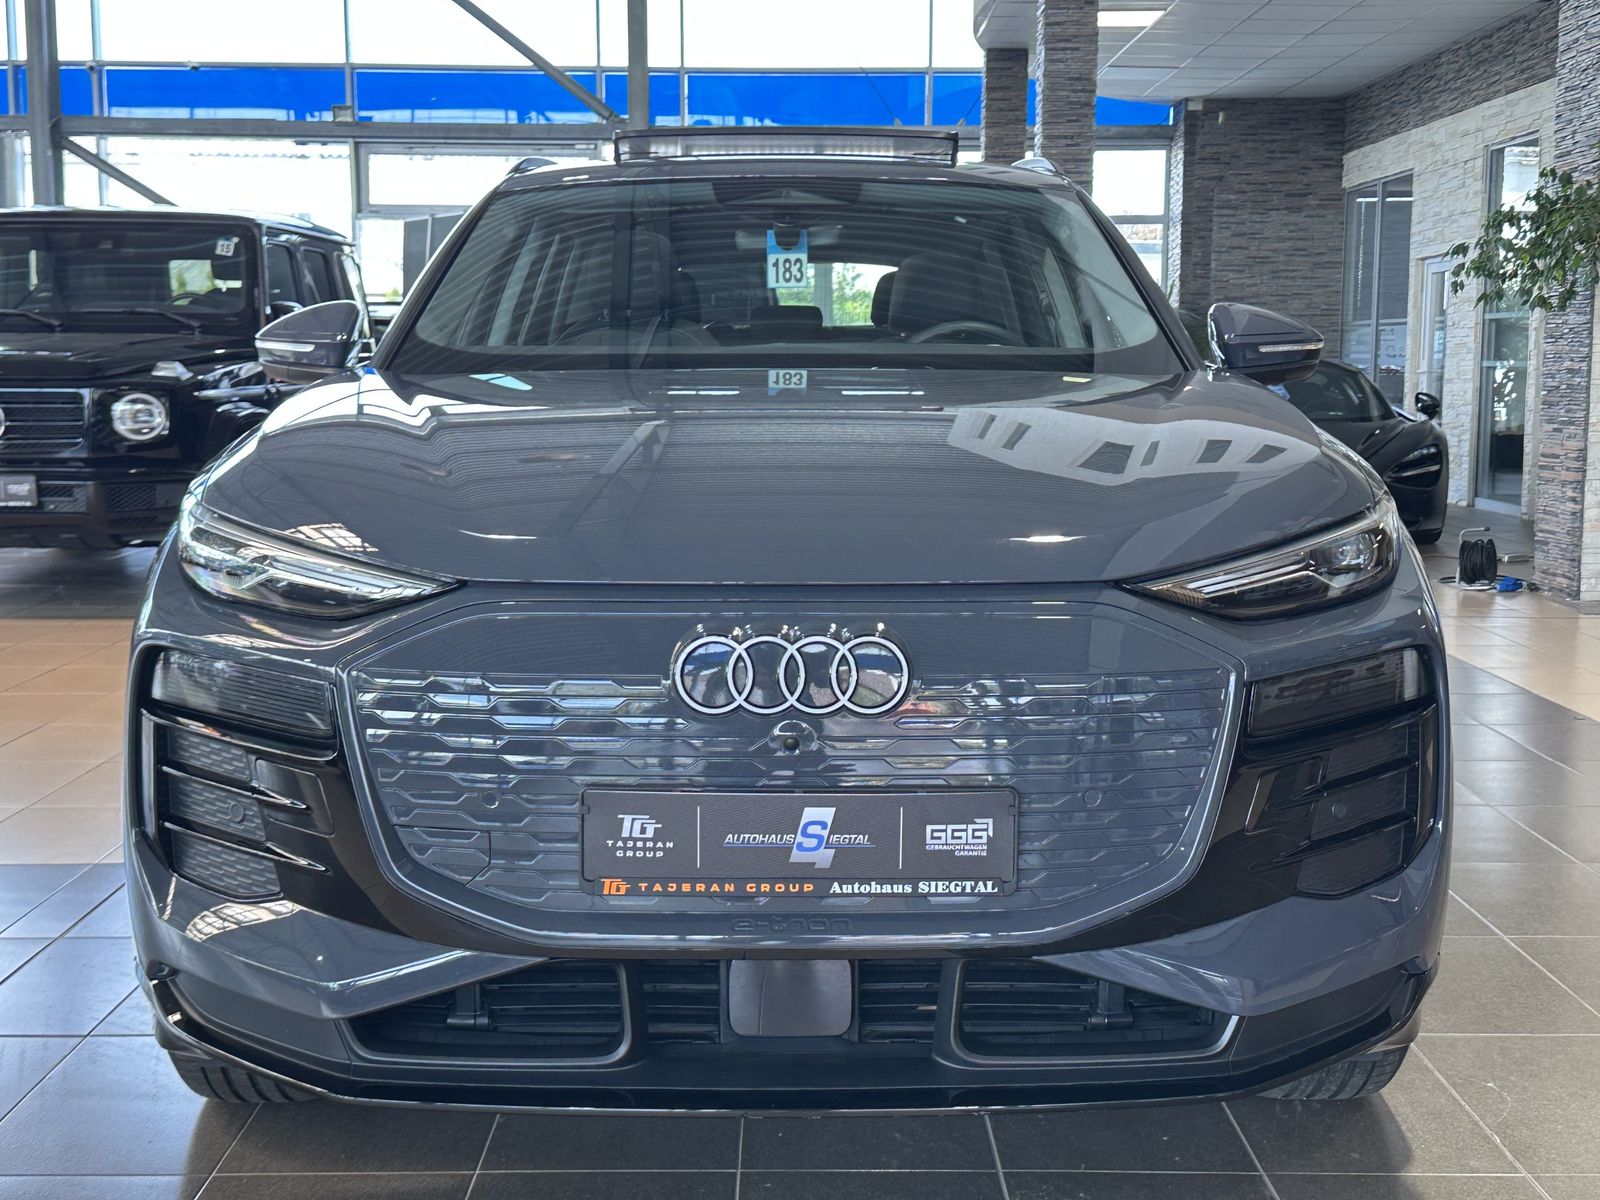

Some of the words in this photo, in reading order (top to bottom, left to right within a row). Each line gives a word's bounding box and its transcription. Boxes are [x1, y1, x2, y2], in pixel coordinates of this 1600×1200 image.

[772, 258, 804, 284] 183
[724, 833, 796, 845] AUTOHAUS
[926, 824, 988, 844] GGG
[606, 840, 674, 849] TAJERAN
[615, 850, 664, 858] GROUP
[638, 882, 735, 893] TAJERAN
[746, 882, 814, 893] GROUP
[829, 881, 913, 894] Autohaus
[918, 880, 998, 893] SIEGTAL
